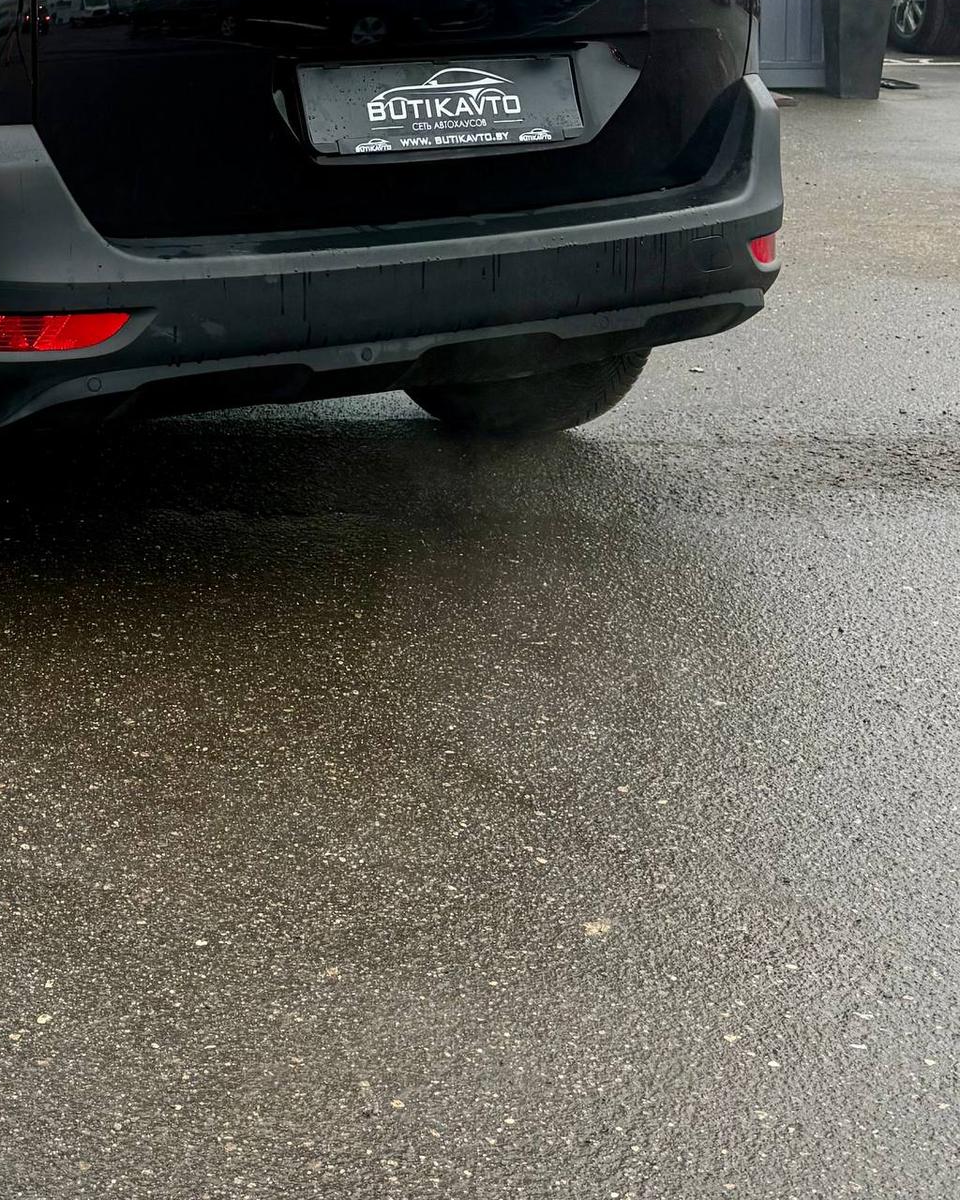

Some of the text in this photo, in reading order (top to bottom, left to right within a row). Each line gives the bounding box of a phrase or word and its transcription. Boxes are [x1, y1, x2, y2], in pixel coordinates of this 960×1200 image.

[367, 95, 522, 121] BUTIKAVTO
[412, 118, 487, 131] СЕТЬ АВТОХАУСОВ
[400, 132, 510, 147] WWW. BUTIKAVTO.BY
